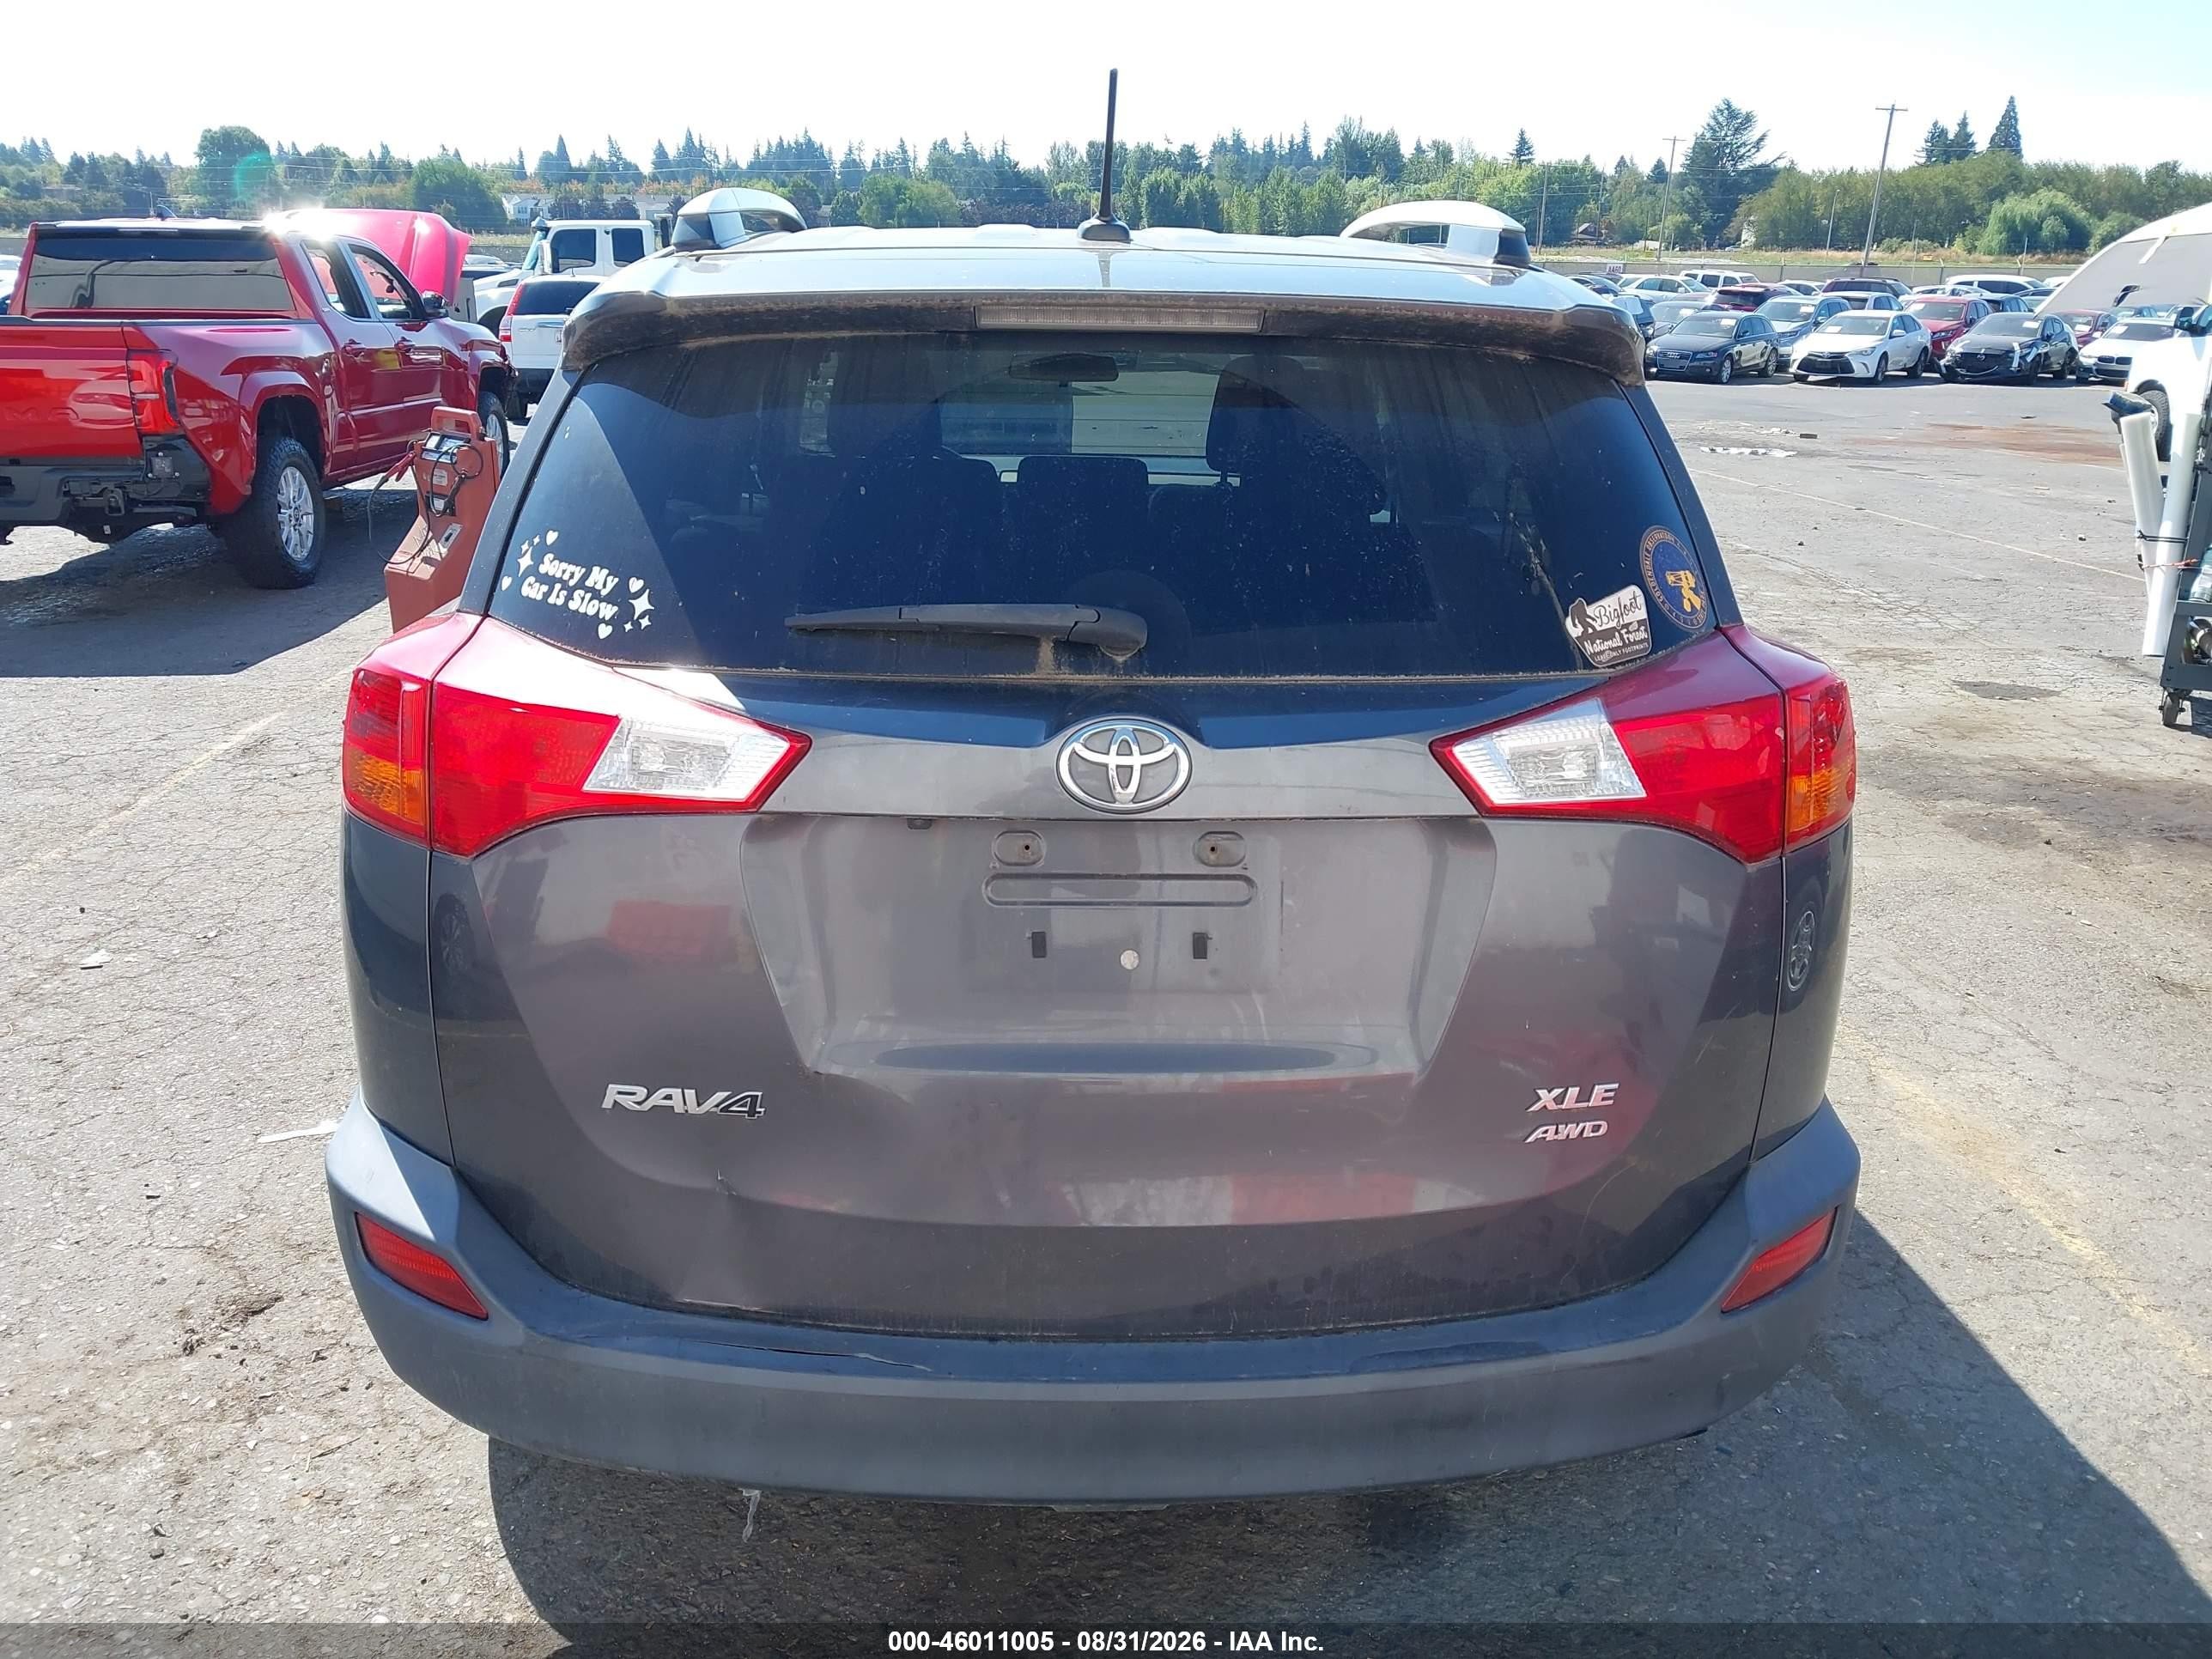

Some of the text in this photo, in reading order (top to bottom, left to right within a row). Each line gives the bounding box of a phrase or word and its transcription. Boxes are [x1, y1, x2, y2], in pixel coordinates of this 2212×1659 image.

[538, 553, 619, 596] Sorry My
[520, 576, 619, 621] Car Is Slow
[1594, 591, 1642, 629] Bigfoot
[1583, 626, 1648, 655] National Forest
[1622, 642, 1649, 653] FOOTPRINTS
[601, 1084, 766, 1119] RAV4
[1526, 1083, 1620, 1112] XLE
[1524, 1121, 1608, 1143] AWD
